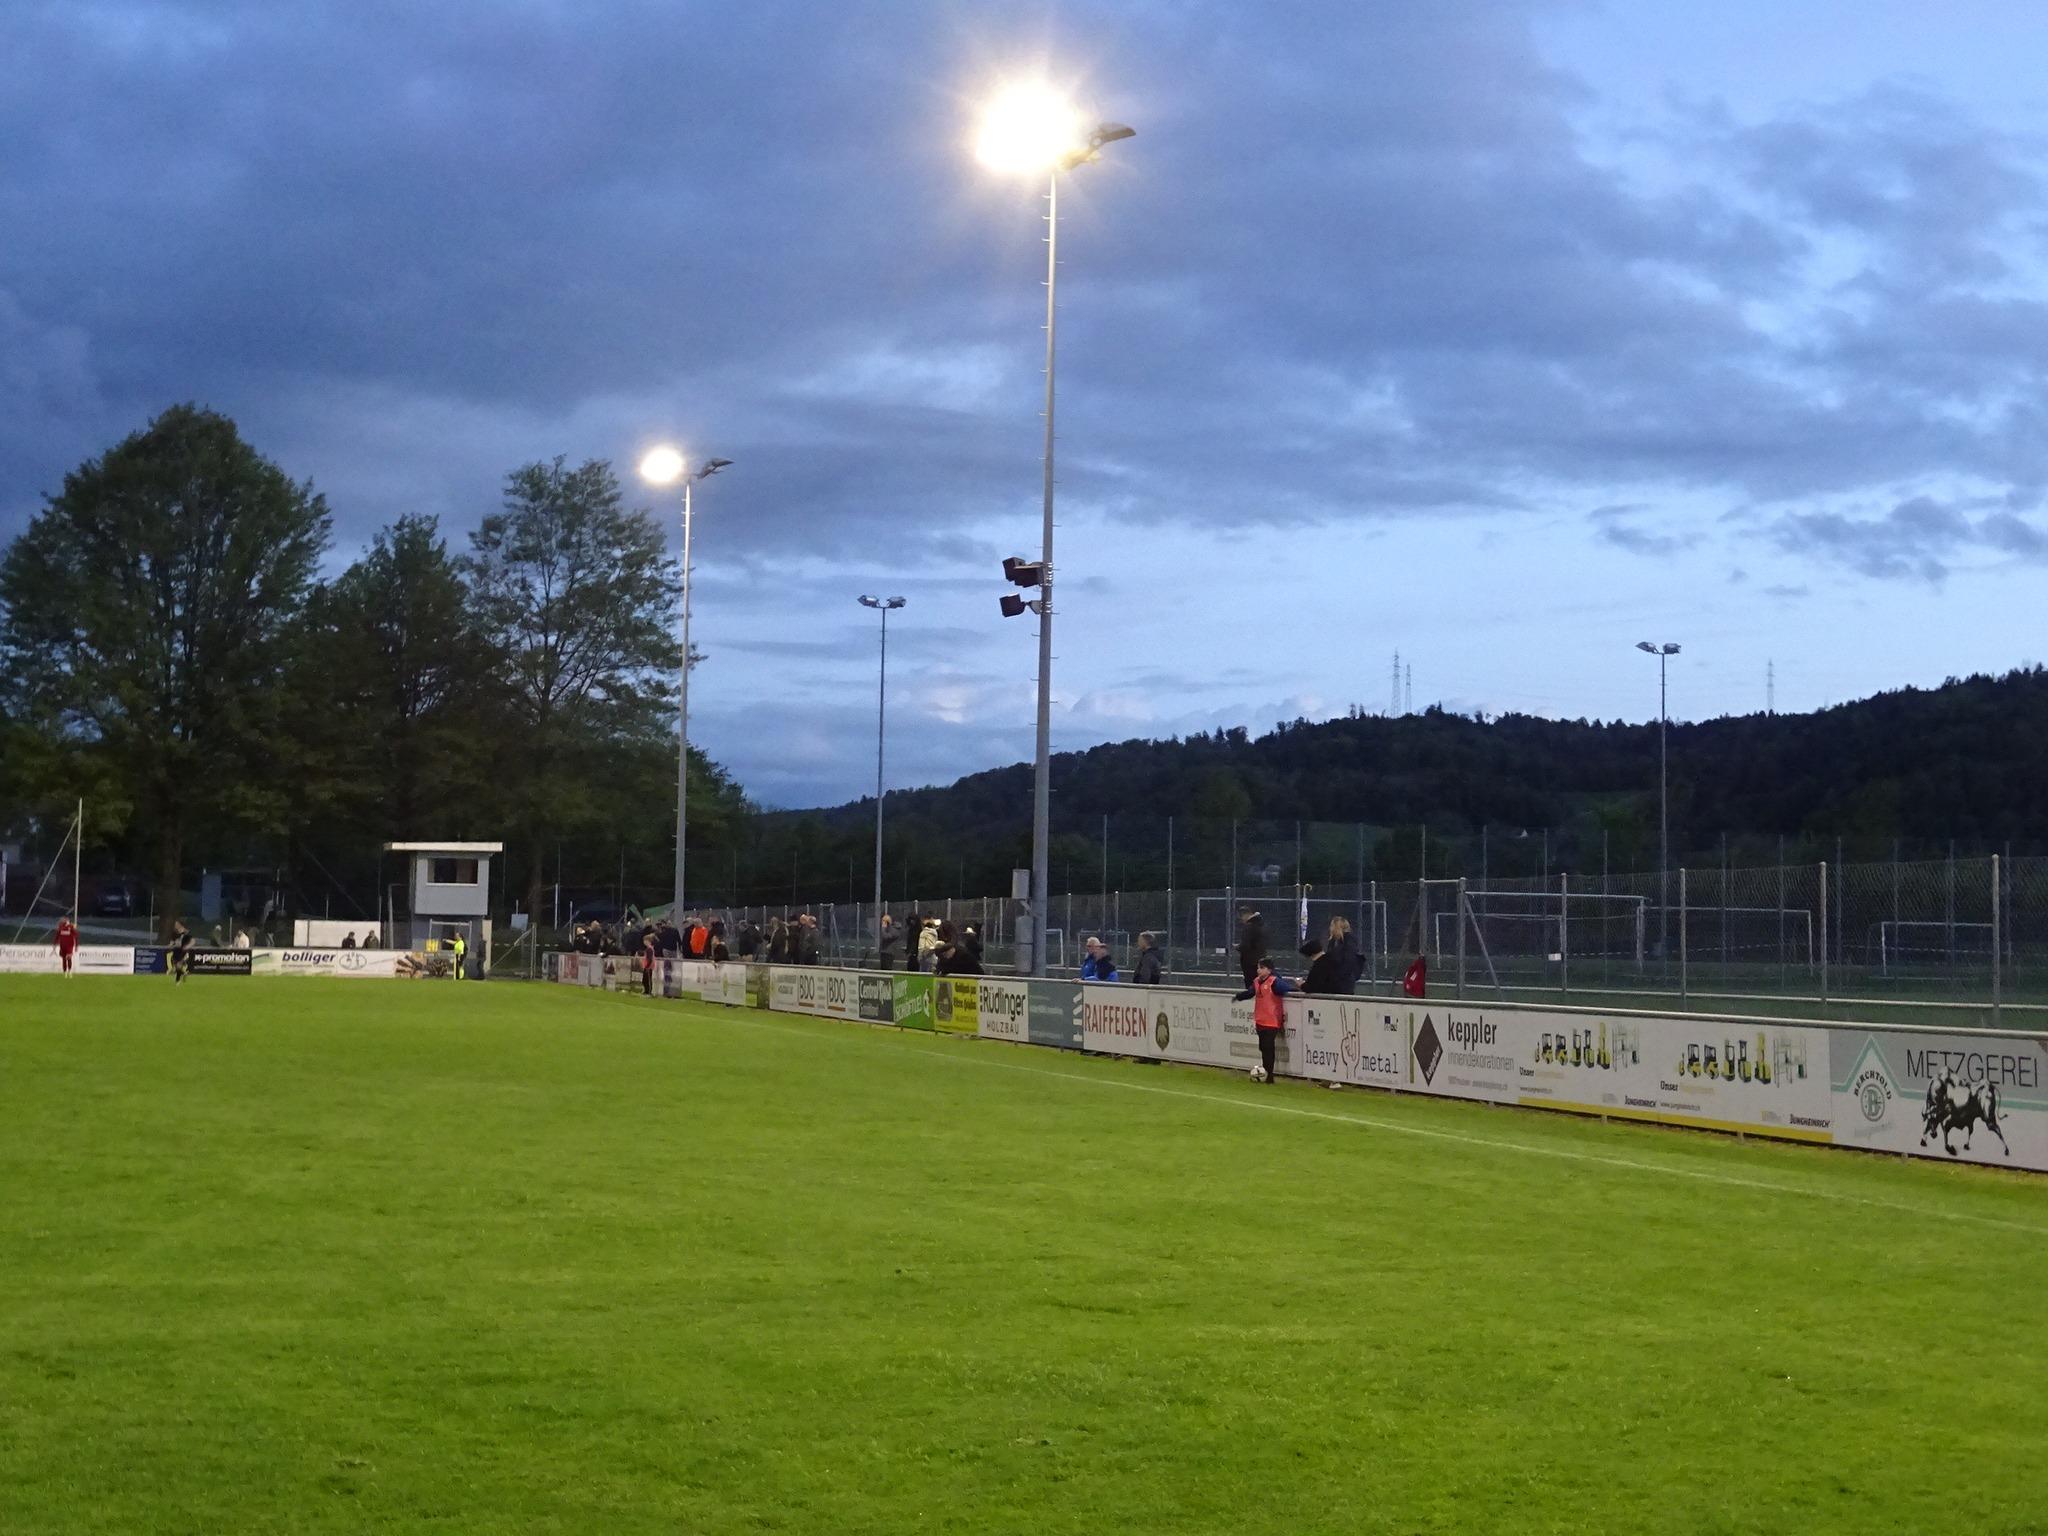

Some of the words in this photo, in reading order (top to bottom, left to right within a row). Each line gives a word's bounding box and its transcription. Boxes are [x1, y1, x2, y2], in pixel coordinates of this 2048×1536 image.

[282, 951, 336, 965] bolliger
[799, 975, 815, 1000] BDO
[828, 976, 846, 1004] BDO
[983, 986, 1026, 1021] Rüdlinger
[986, 1021, 1019, 1035] HOLZBAU
[1084, 1003, 1147, 1038] RAIFFEISEN
[1448, 1013, 1497, 1051] keppler
[1305, 1043, 1340, 1073] heavy
[1362, 1053, 1399, 1074] metal
[1447, 1051, 1515, 1071] innendekorationen
[1519, 1066, 1535, 1077] Unser
[1906, 1049, 2039, 1088] METZGEREI
[1660, 1080, 1679, 1091] Unser
[1853, 1069, 1892, 1100] BERCHTOLD
[1790, 1113, 1831, 1129] JUNGHEINRICH
